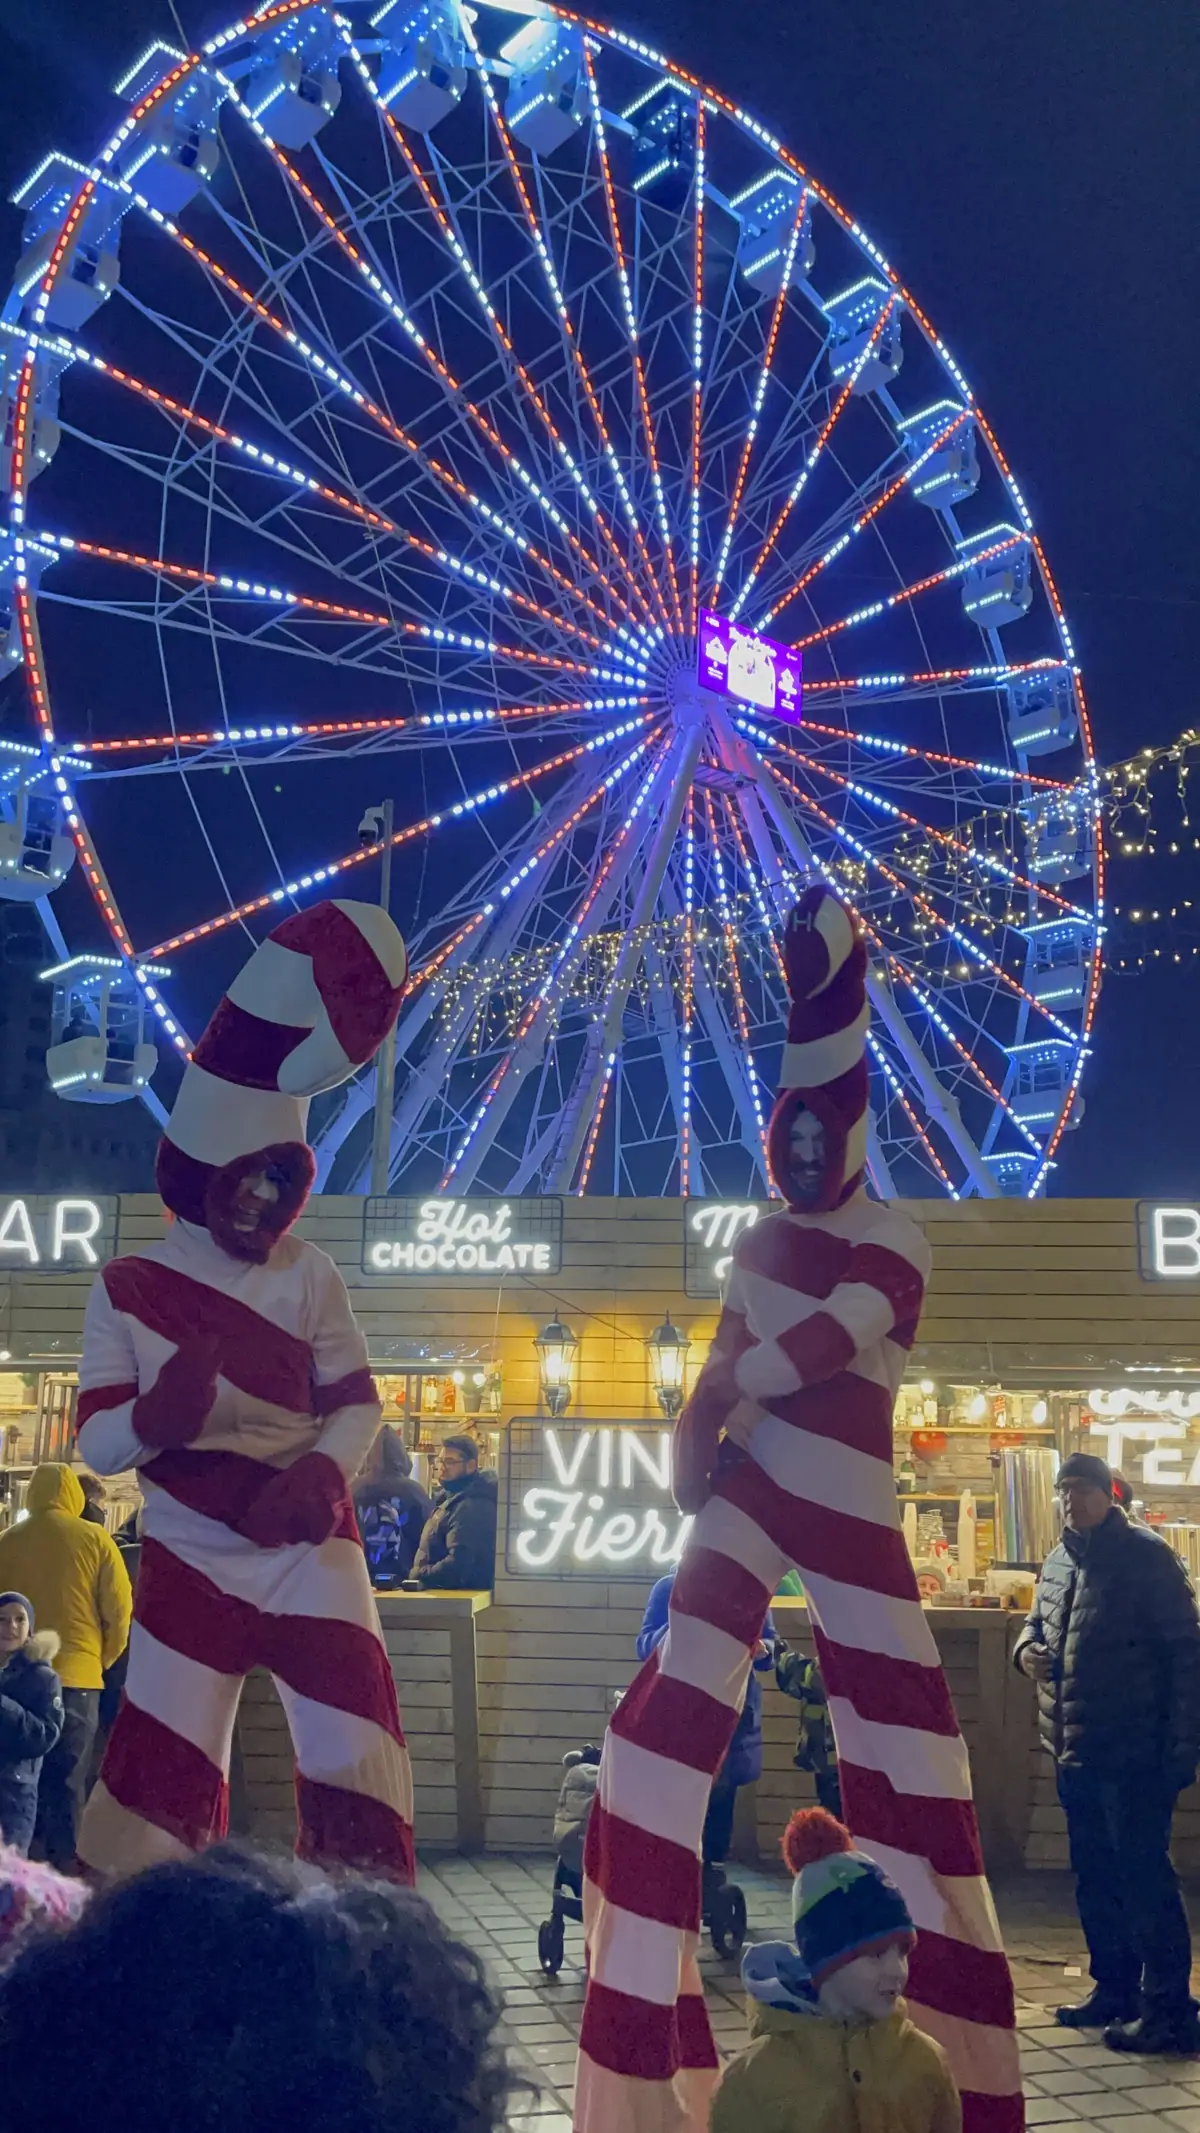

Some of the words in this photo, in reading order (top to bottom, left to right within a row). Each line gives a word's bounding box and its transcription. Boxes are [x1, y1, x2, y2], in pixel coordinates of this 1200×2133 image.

[416, 1200, 513, 1244] Hot
[371, 1241, 551, 1271] CHOCOLATE
[545, 1428, 672, 1489] VIN
[1089, 1421, 1200, 1486] TE
